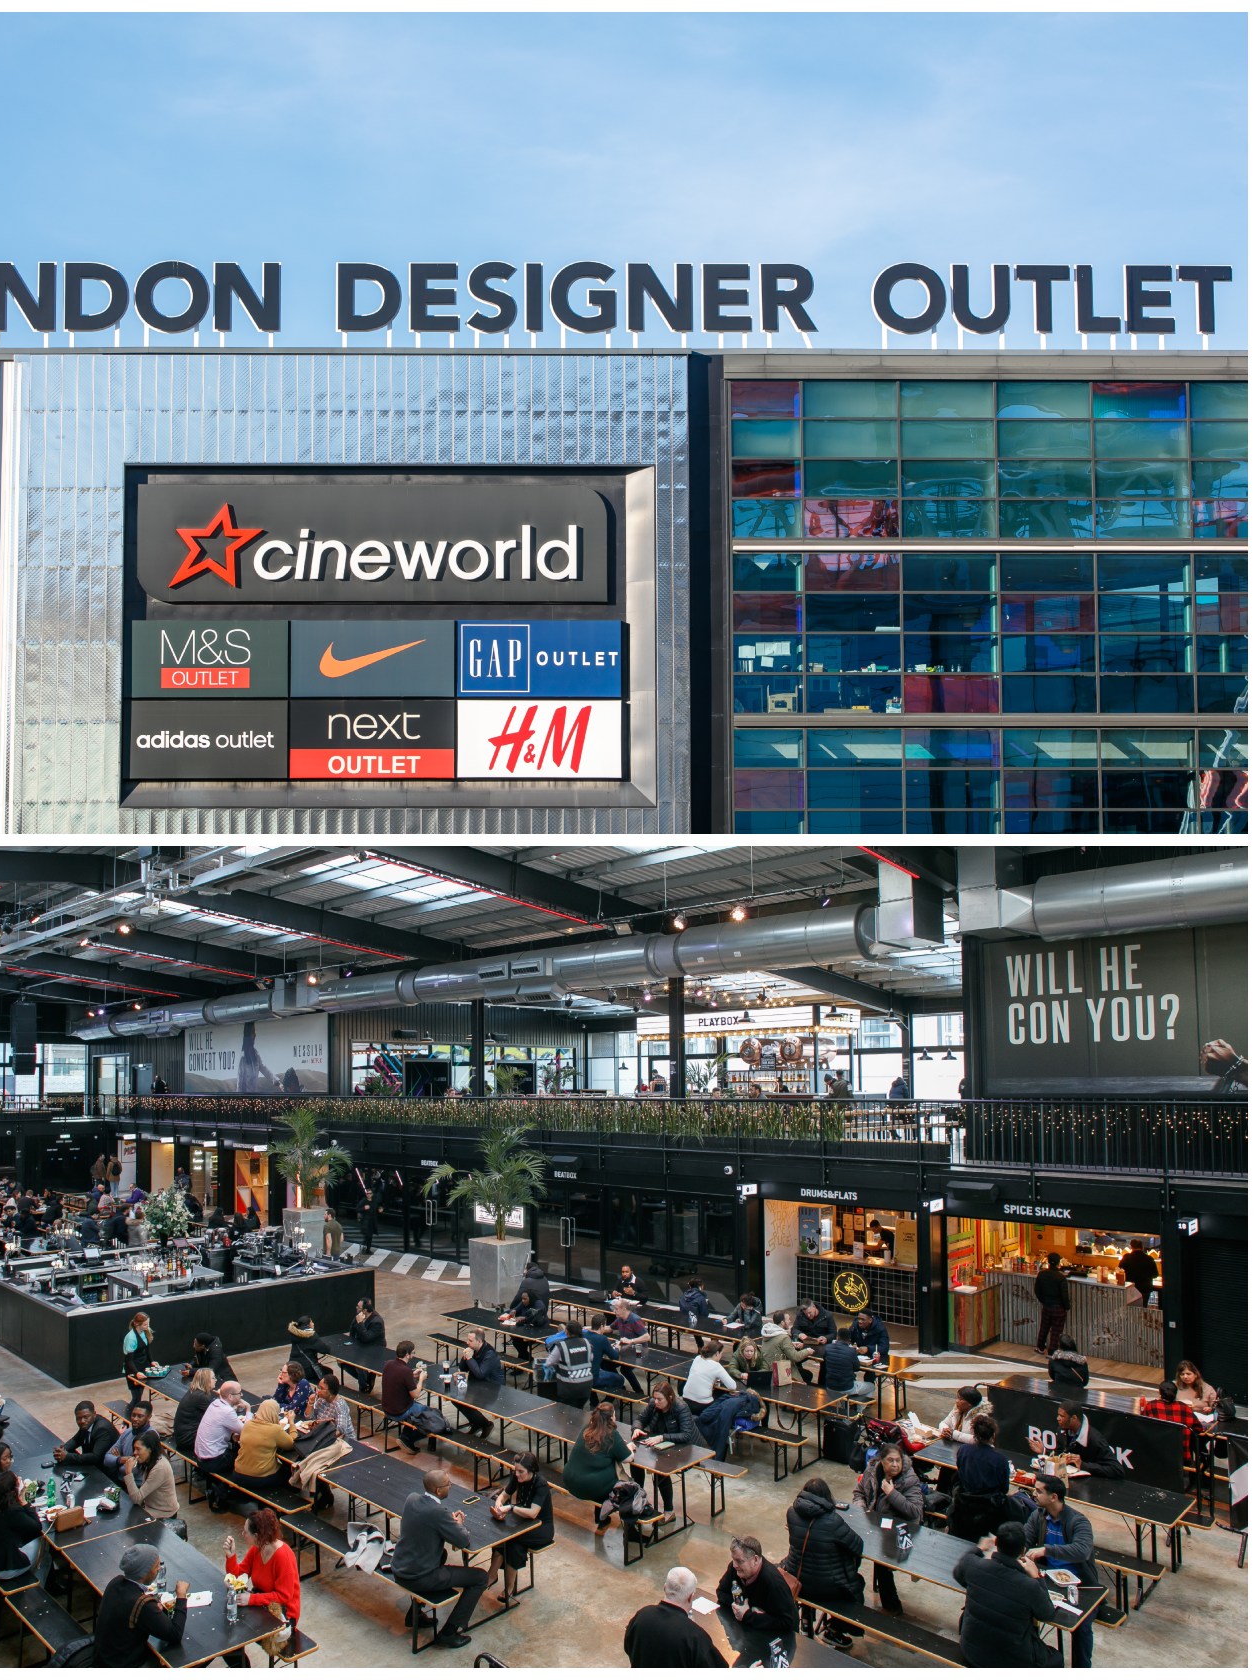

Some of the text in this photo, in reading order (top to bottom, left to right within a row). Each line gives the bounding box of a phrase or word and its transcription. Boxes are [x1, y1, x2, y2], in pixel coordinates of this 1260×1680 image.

[336, 260, 818, 335] DESIGNER
[871, 261, 1233, 335] OUTLET
[253, 524, 578, 581] cineworld
[161, 629, 251, 665] M&S
[469, 639, 619, 678] GAP OUTLET
[172, 671, 239, 686] OUTLET
[328, 712, 421, 740] next
[136, 731, 275, 748] adidas outlet
[488, 705, 592, 773] H&M
[328, 755, 421, 774] OUTLET
[1006, 944, 1142, 998] WILL HE
[698, 1016, 740, 1027] PLAYBOX
[1008, 994, 1180, 1044] CON YOU?
[189, 1032, 213, 1051] WILL HE
[188, 1051, 236, 1071] CONVERT YOU?
[554, 1170, 576, 1179] BEATBOX
[800, 1188, 858, 1200] DRUMS&FLATS
[1004, 1204, 1071, 1219] SPICE SHACK
